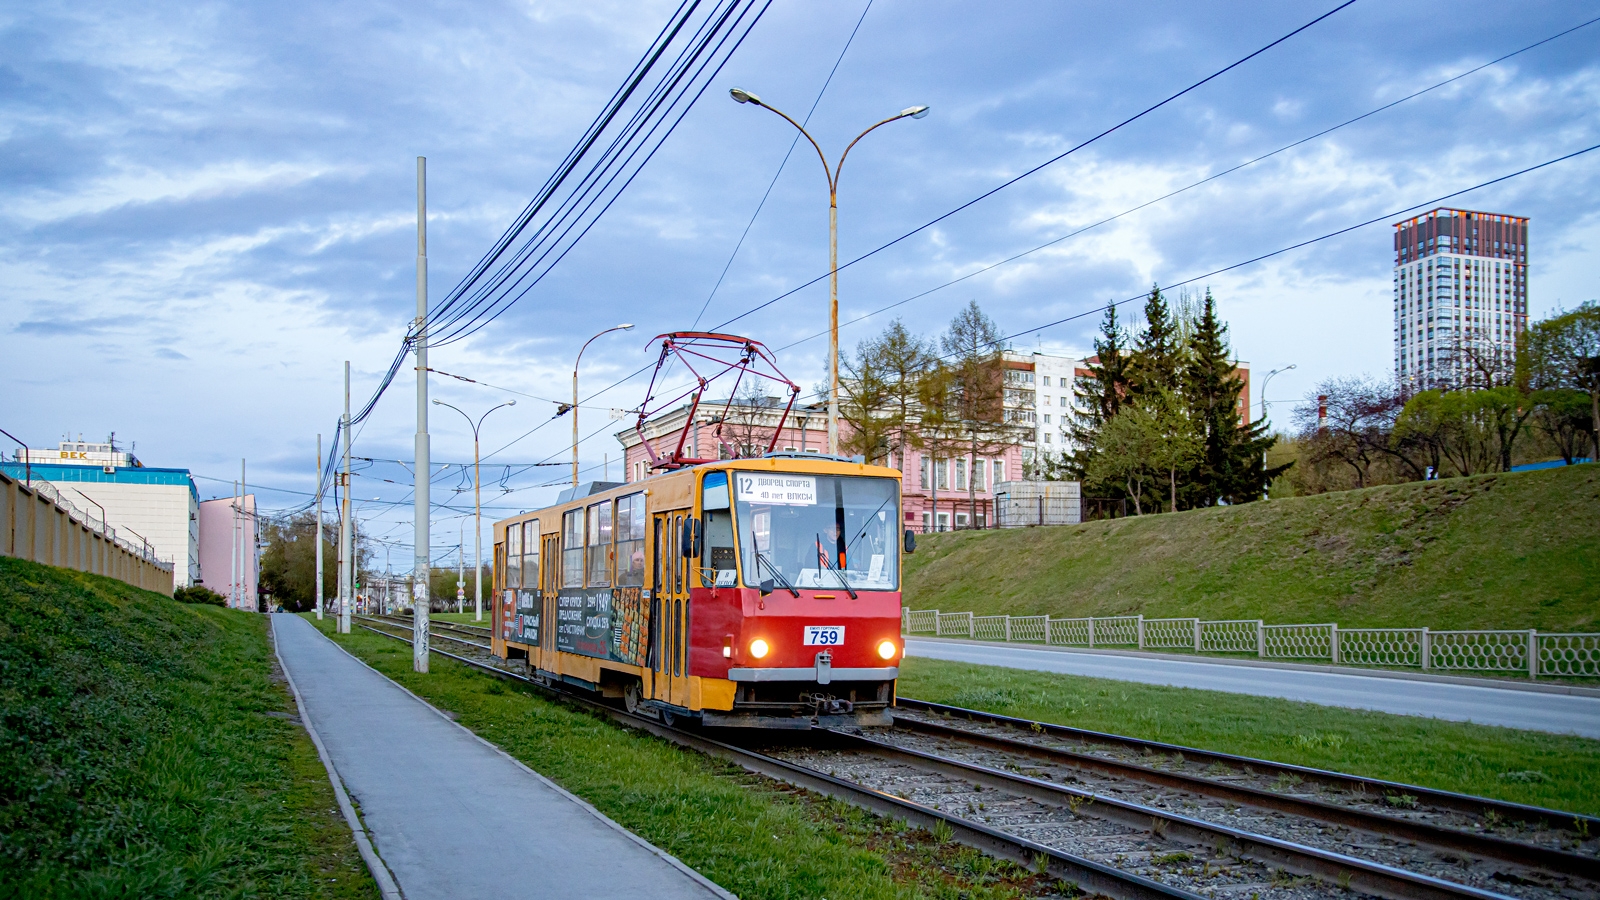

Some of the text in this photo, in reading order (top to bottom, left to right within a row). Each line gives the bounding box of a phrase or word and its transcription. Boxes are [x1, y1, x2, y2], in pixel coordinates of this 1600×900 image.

[60, 451, 87, 459] ВЕК
[740, 478, 753, 494] 12
[761, 491, 769, 499] 40
[787, 492, 812, 500] ВЛКСМ
[810, 631, 838, 645] 759
